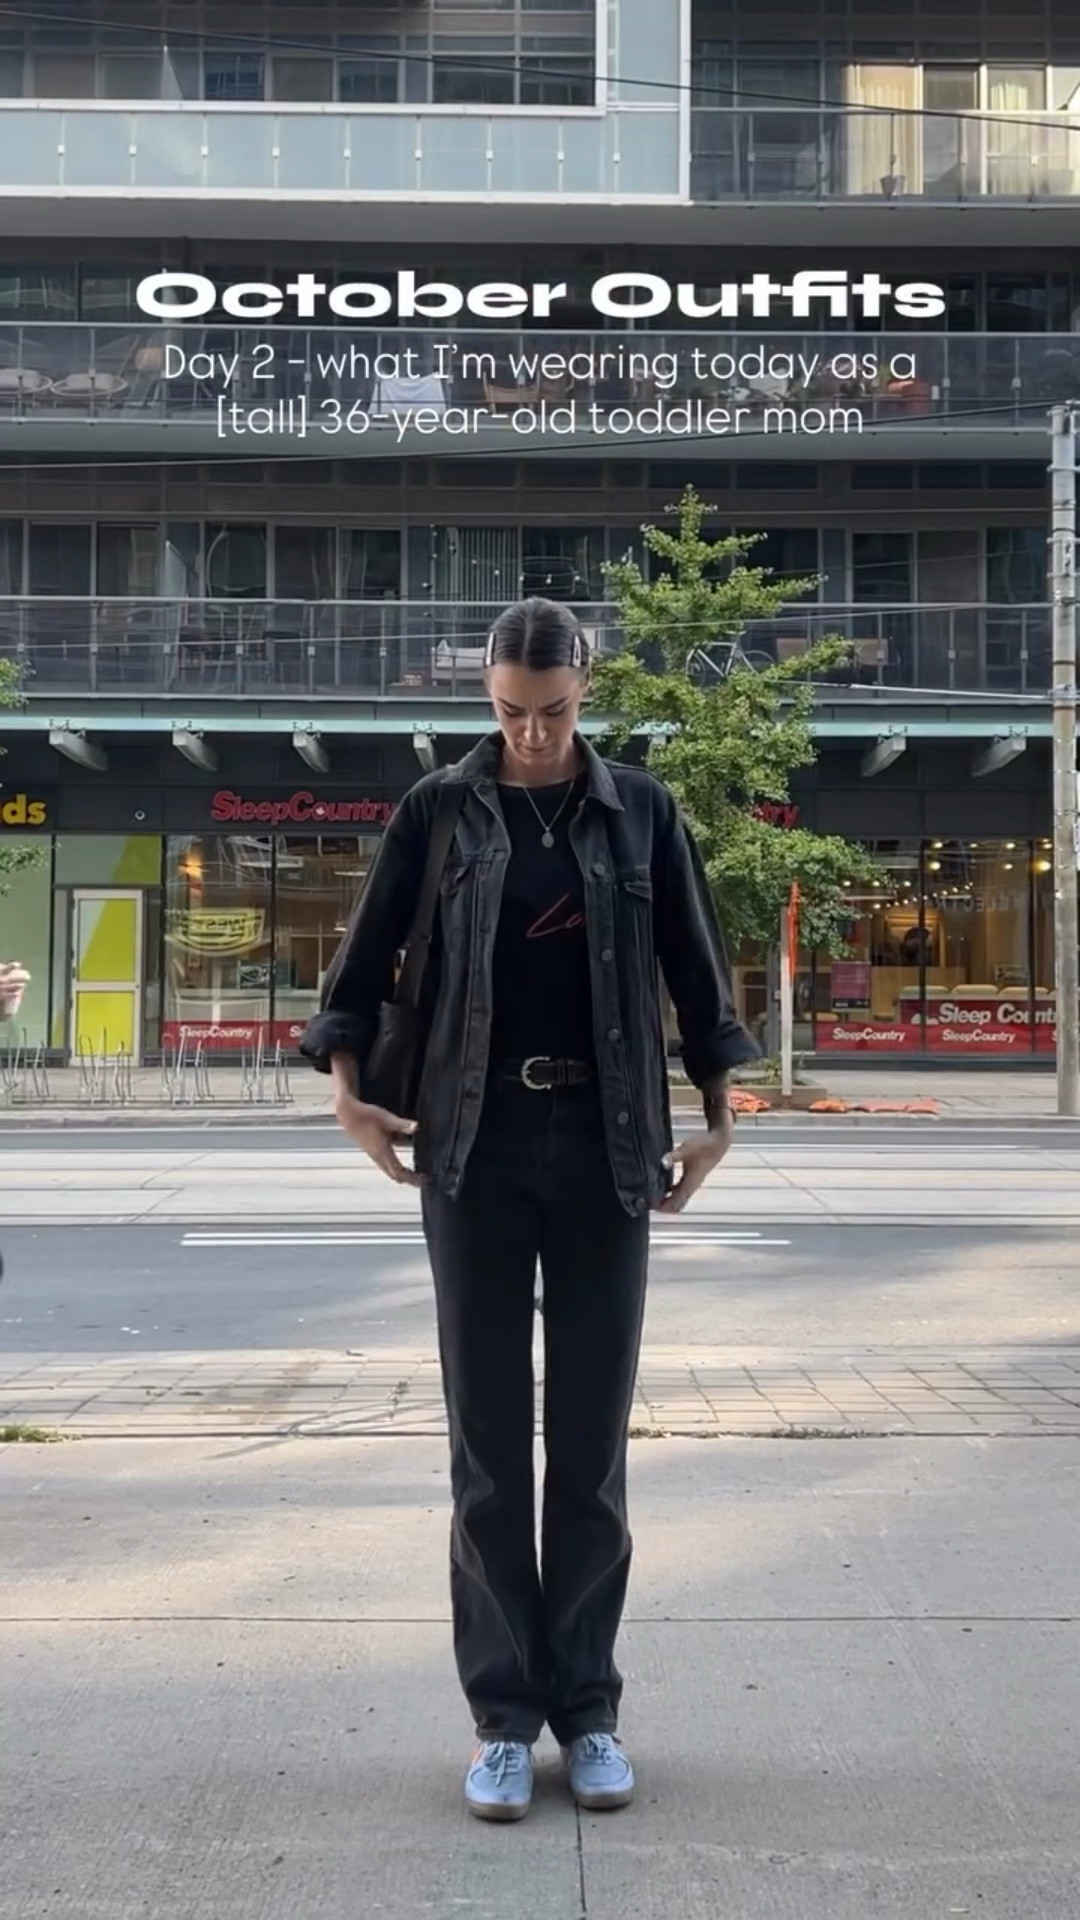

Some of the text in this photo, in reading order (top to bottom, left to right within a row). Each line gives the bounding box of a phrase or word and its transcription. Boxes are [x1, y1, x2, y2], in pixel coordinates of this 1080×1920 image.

[939, 1003, 992, 1025] Sleep
[833, 1027, 906, 1042] SleepCountry
[941, 1028, 1015, 1043] SleepCountry
